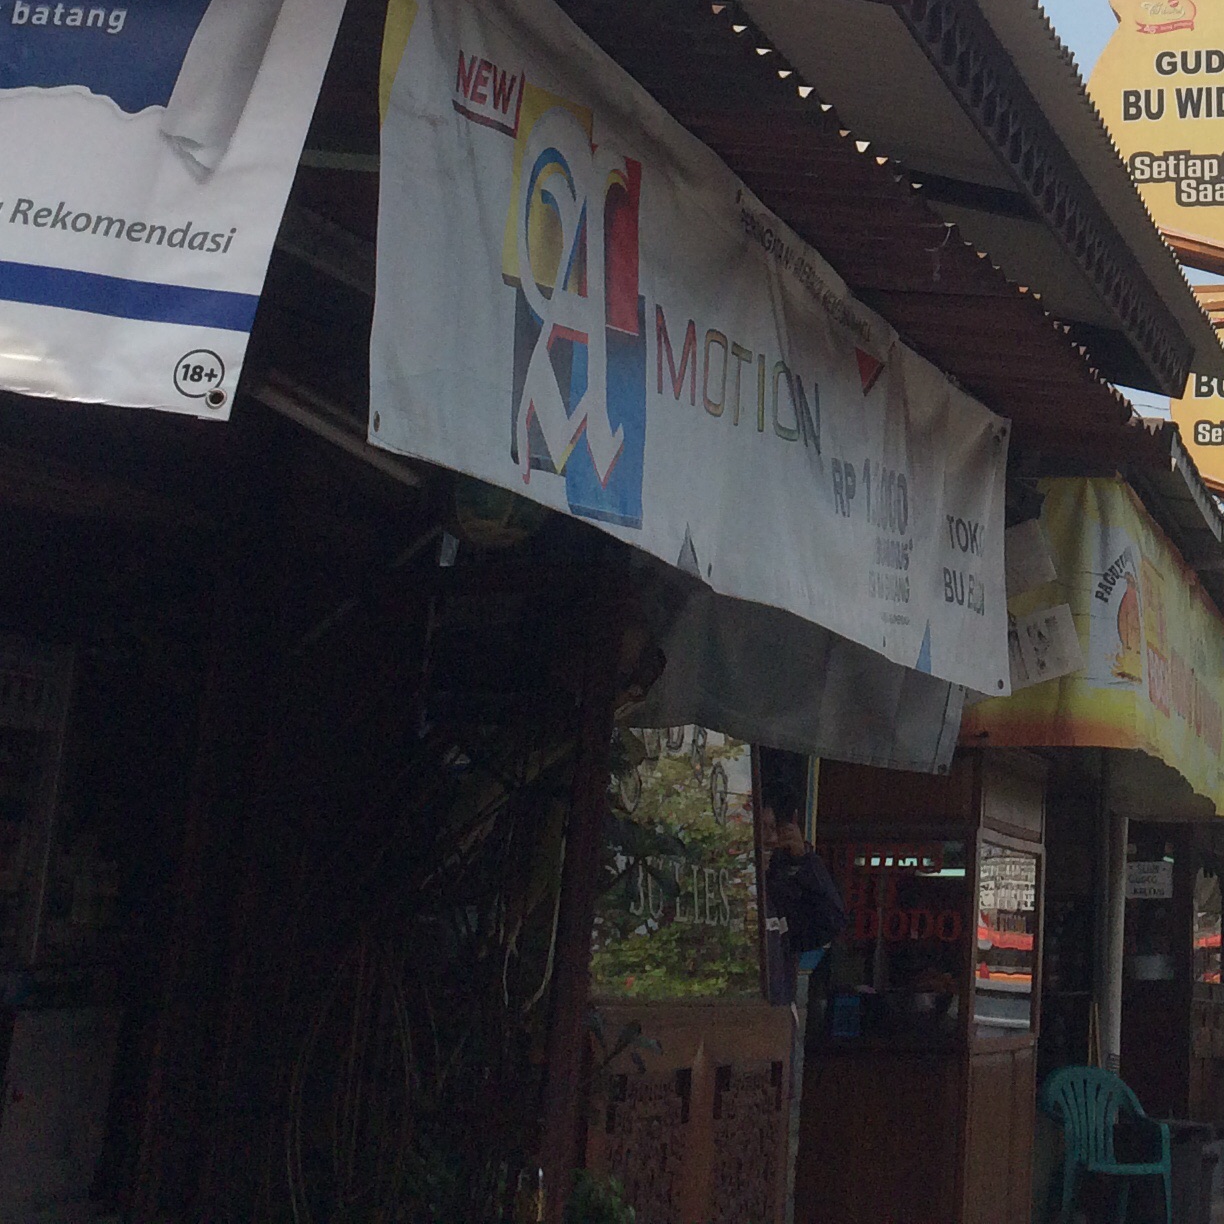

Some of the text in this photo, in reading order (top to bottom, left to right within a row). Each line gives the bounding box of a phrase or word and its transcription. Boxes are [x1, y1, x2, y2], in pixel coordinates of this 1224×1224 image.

[12, 0, 128, 34] batang
[455, 49, 517, 115] NEW
[1122, 88, 1165, 121] BU
[1133, 155, 1219, 181] Setiap
[10, 198, 237, 255] Rekomendasi
[180, 364, 219, 384] 18+
[655, 303, 822, 456] MOTION
[831, 457, 857, 518] RP
[943, 566, 965, 606] BU
[669, 861, 731, 928] LIES
